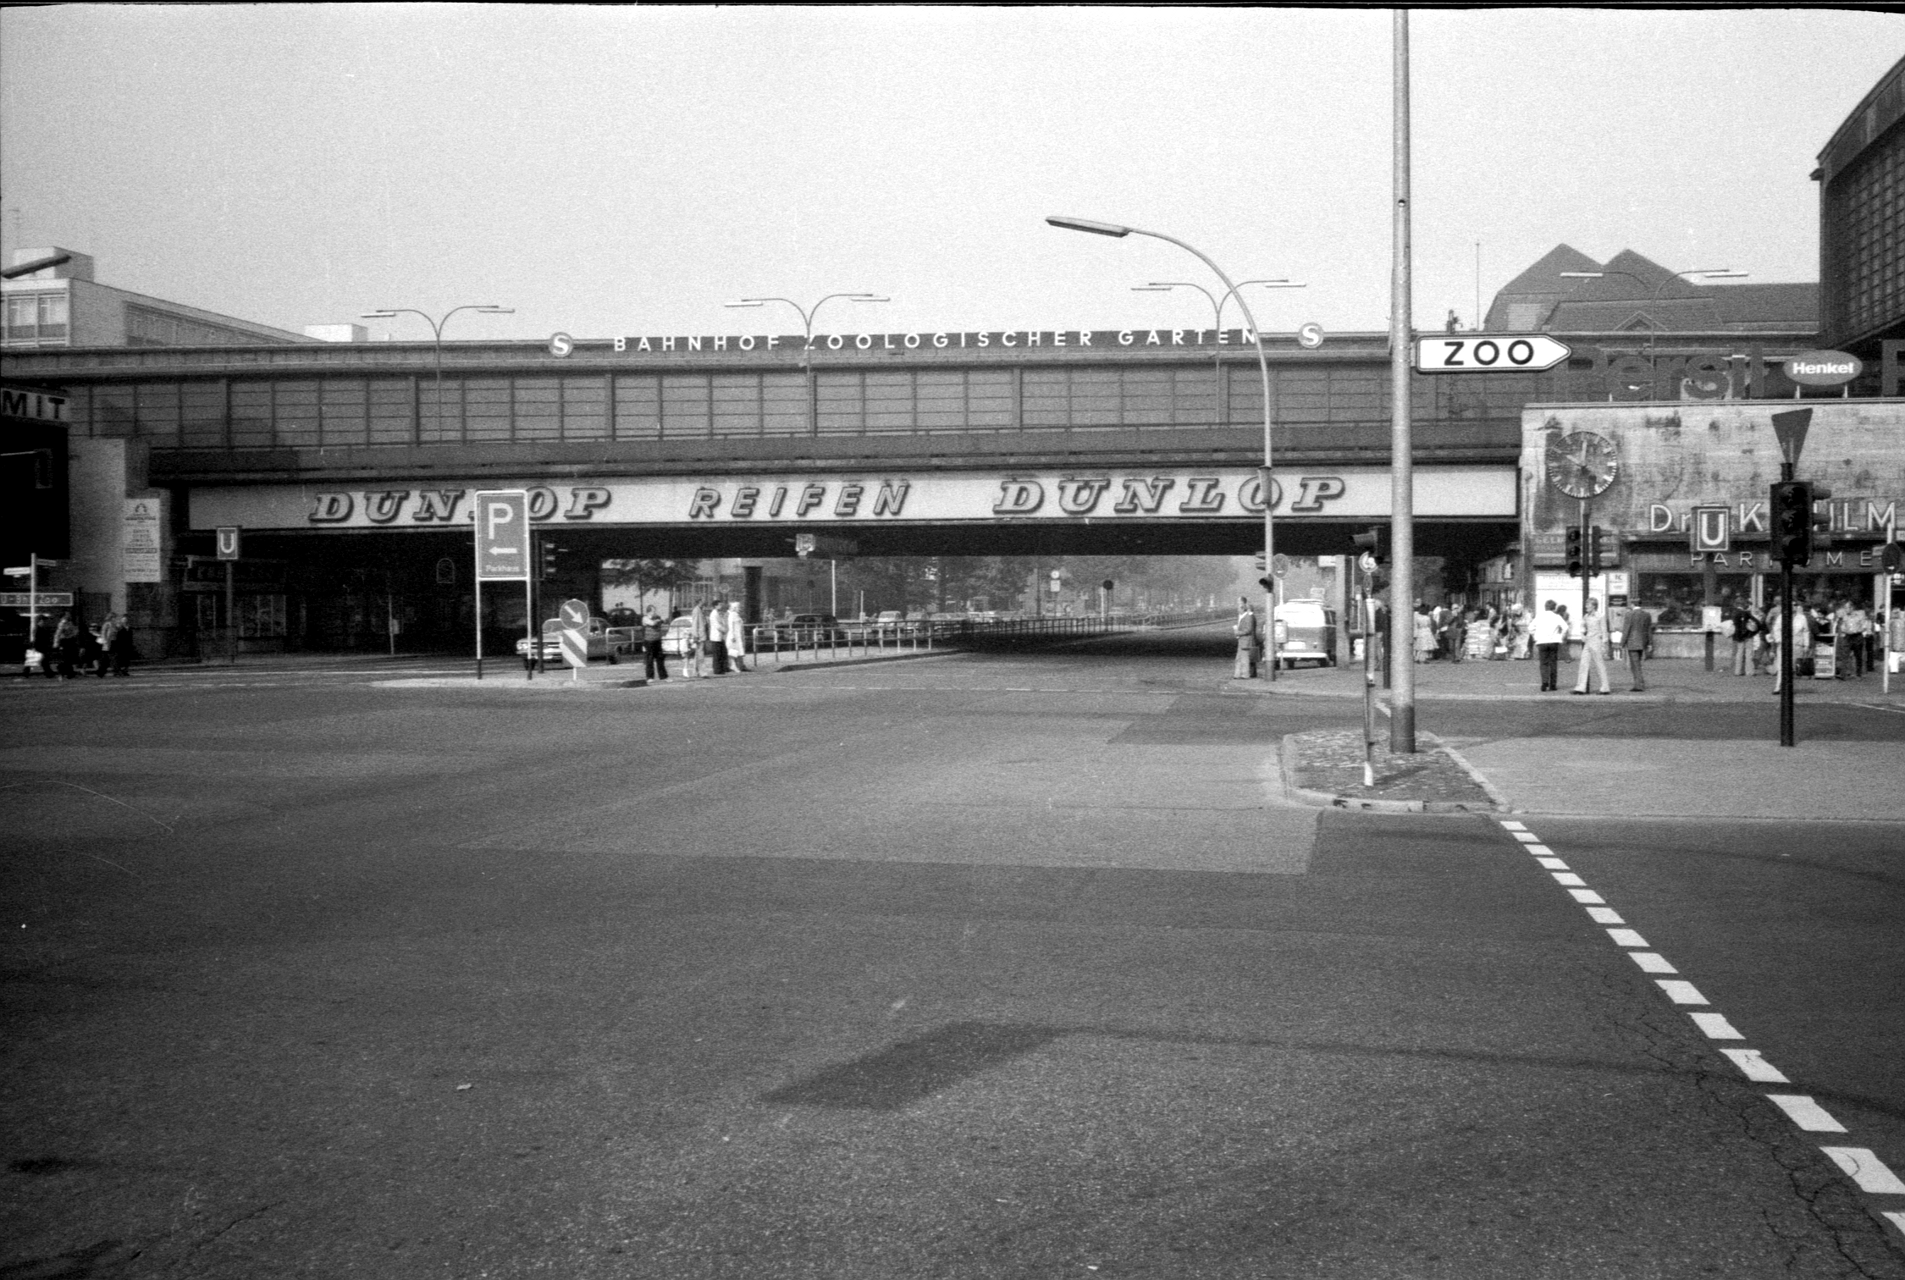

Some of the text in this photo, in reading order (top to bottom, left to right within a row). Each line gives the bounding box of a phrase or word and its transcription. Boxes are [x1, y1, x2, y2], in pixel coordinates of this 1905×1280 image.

[614, 328, 1257, 351] BAHNHOF ZOOLOGISCHER GARTEN
[1443, 339, 1535, 366] ZOO
[1554, 343, 1765, 400] Persil
[1793, 361, 1854, 375] Henkel
[308, 483, 911, 524] DUNOP REIFEN
[993, 476, 1346, 515] DUNLOP
[487, 502, 514, 540] P
[1701, 513, 1725, 546] U
[220, 532, 235, 553] U
